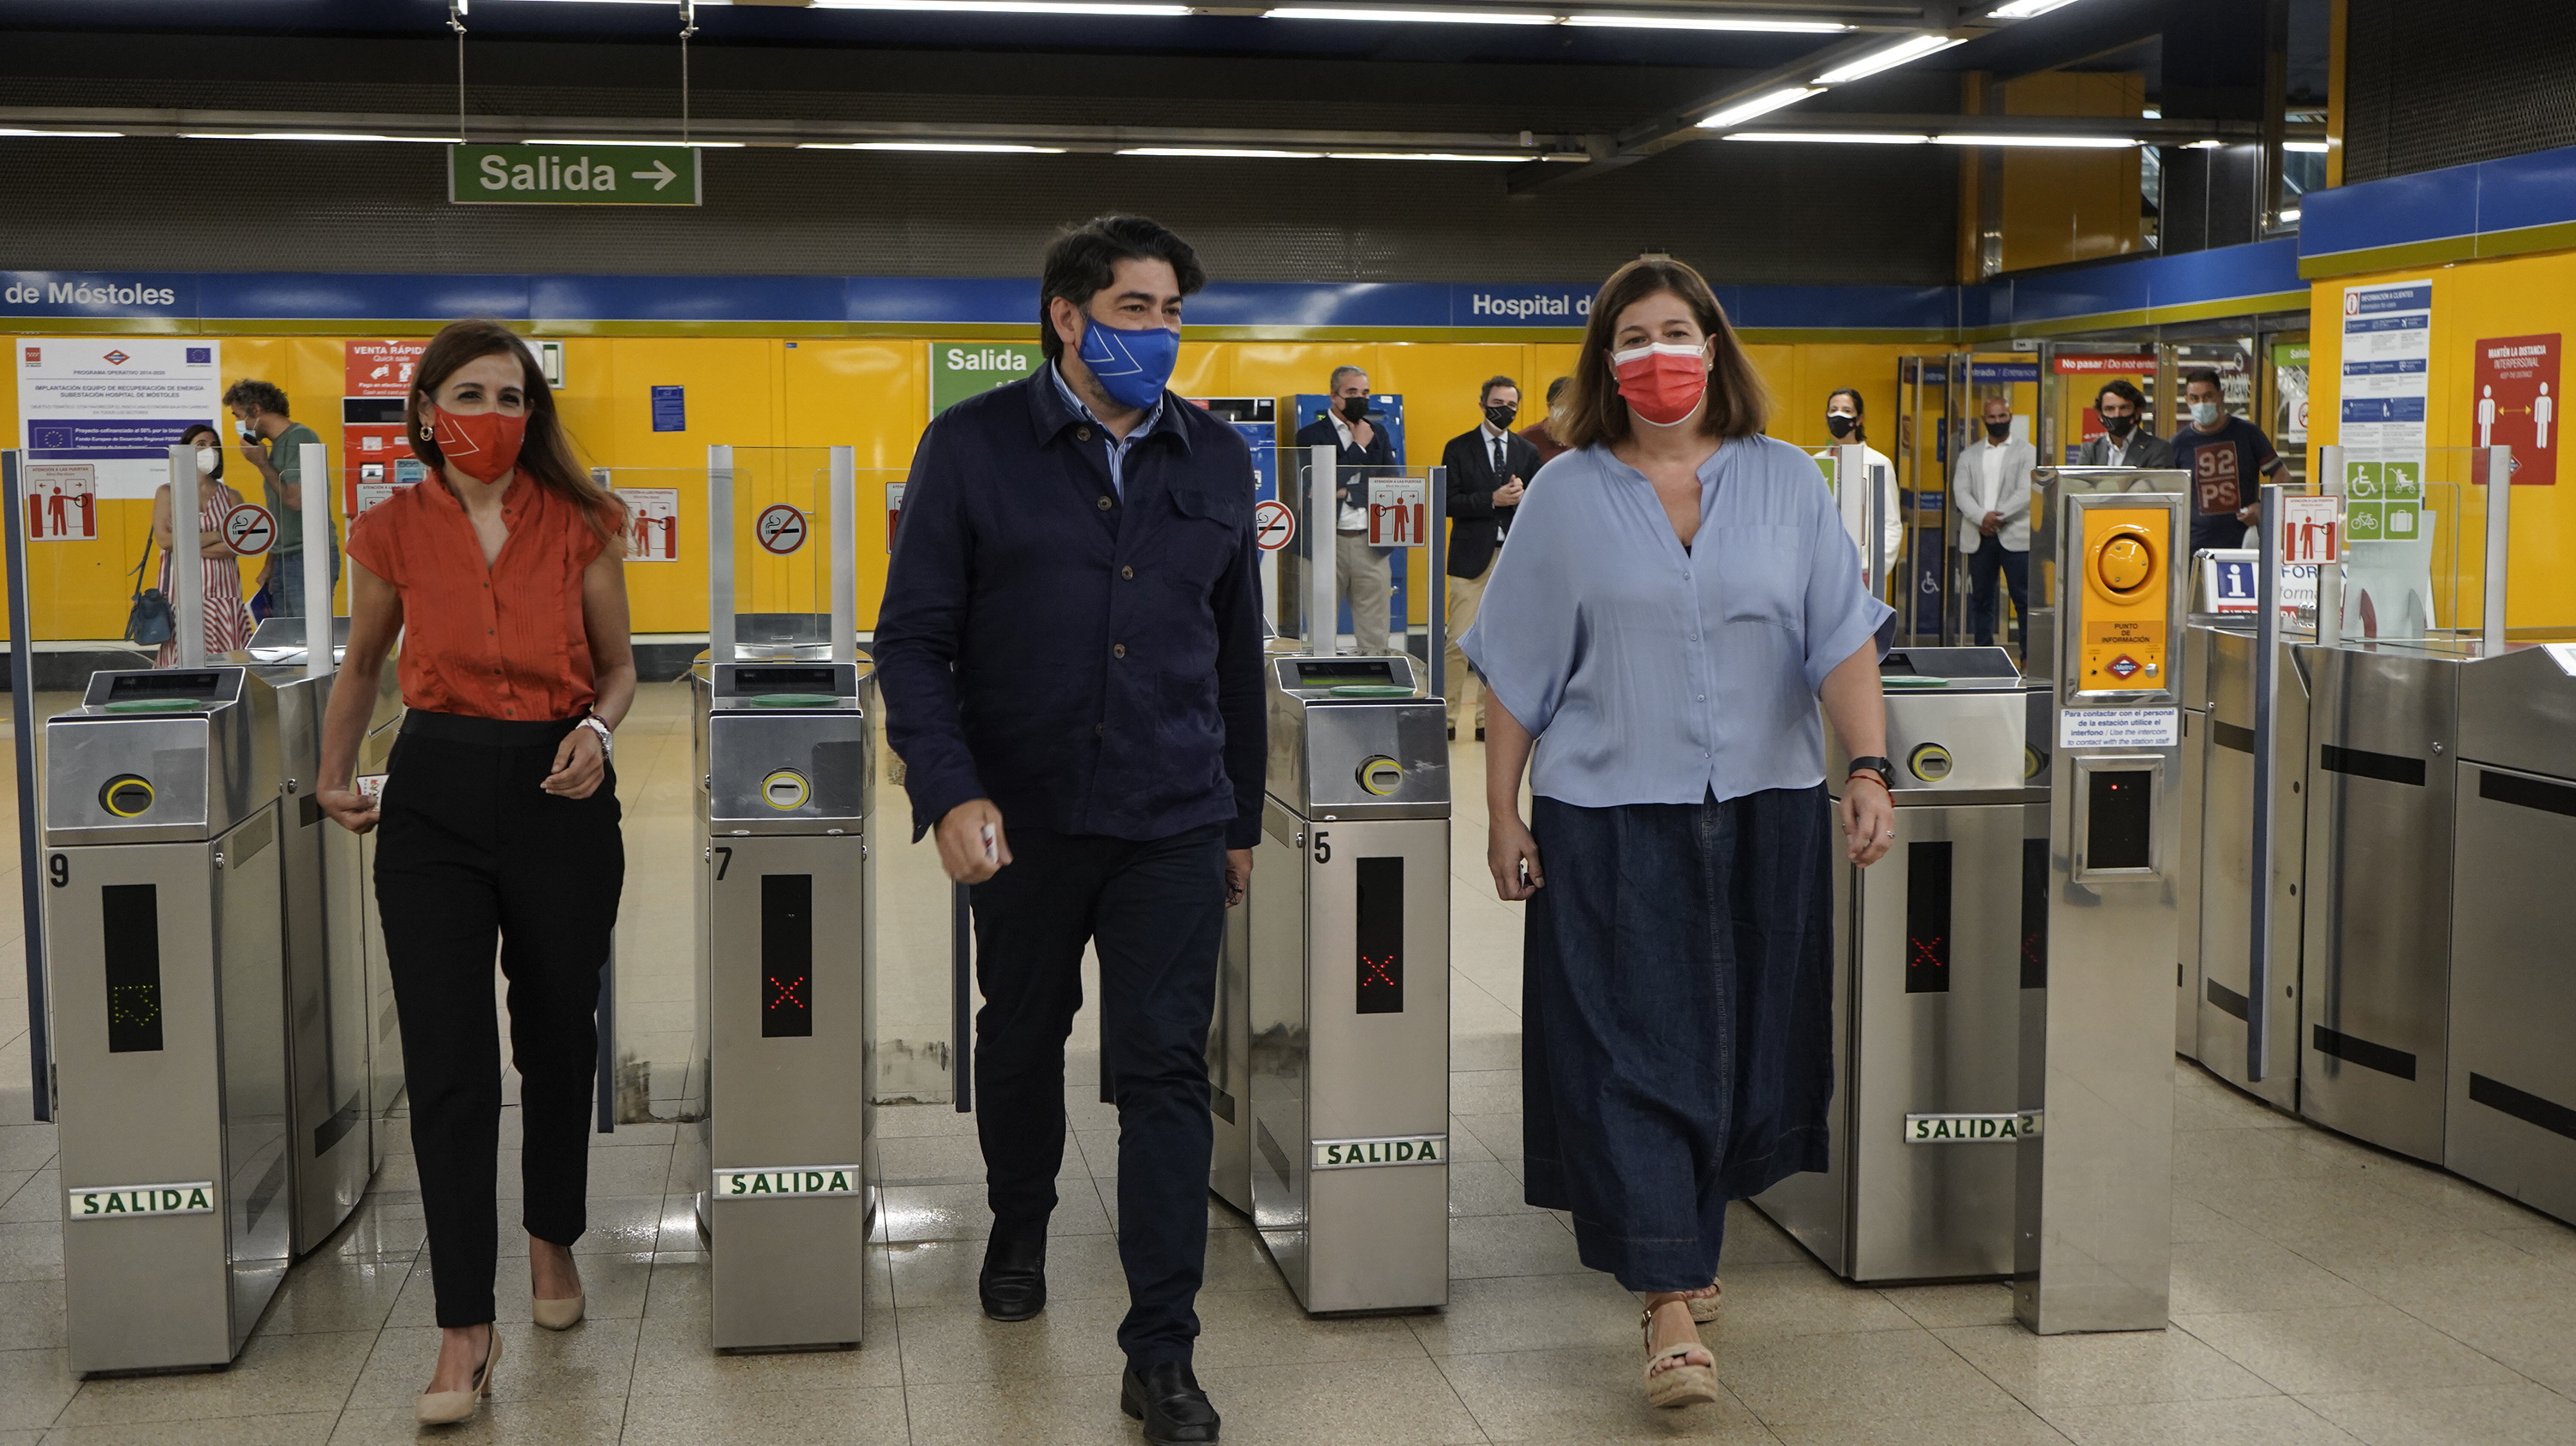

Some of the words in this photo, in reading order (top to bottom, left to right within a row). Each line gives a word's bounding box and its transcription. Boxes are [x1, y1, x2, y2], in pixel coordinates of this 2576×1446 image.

[480, 155, 616, 191] Salida
[5, 282, 40, 303] de
[48, 282, 175, 305] Móstoles
[1473, 294, 1570, 320] Hospital
[1576, 295, 1593, 315] d
[354, 346, 387, 355] VENTA
[947, 349, 1027, 370] Salida
[2062, 359, 2076, 368] No
[2078, 361, 2103, 370] pasar
[2108, 359, 2121, 368] Do
[2122, 360, 2136, 368] not
[2198, 449, 2235, 477] 92
[2201, 481, 2238, 509] PS
[1315, 831, 1331, 864] 5
[50, 853, 69, 888] 9
[715, 846, 733, 881] 7
[1917, 1119, 2018, 1138] SALIDA
[1327, 1141, 1437, 1165] SALIDA
[731, 1171, 849, 1195] SALIDA
[83, 1188, 209, 1215] SALIDA
